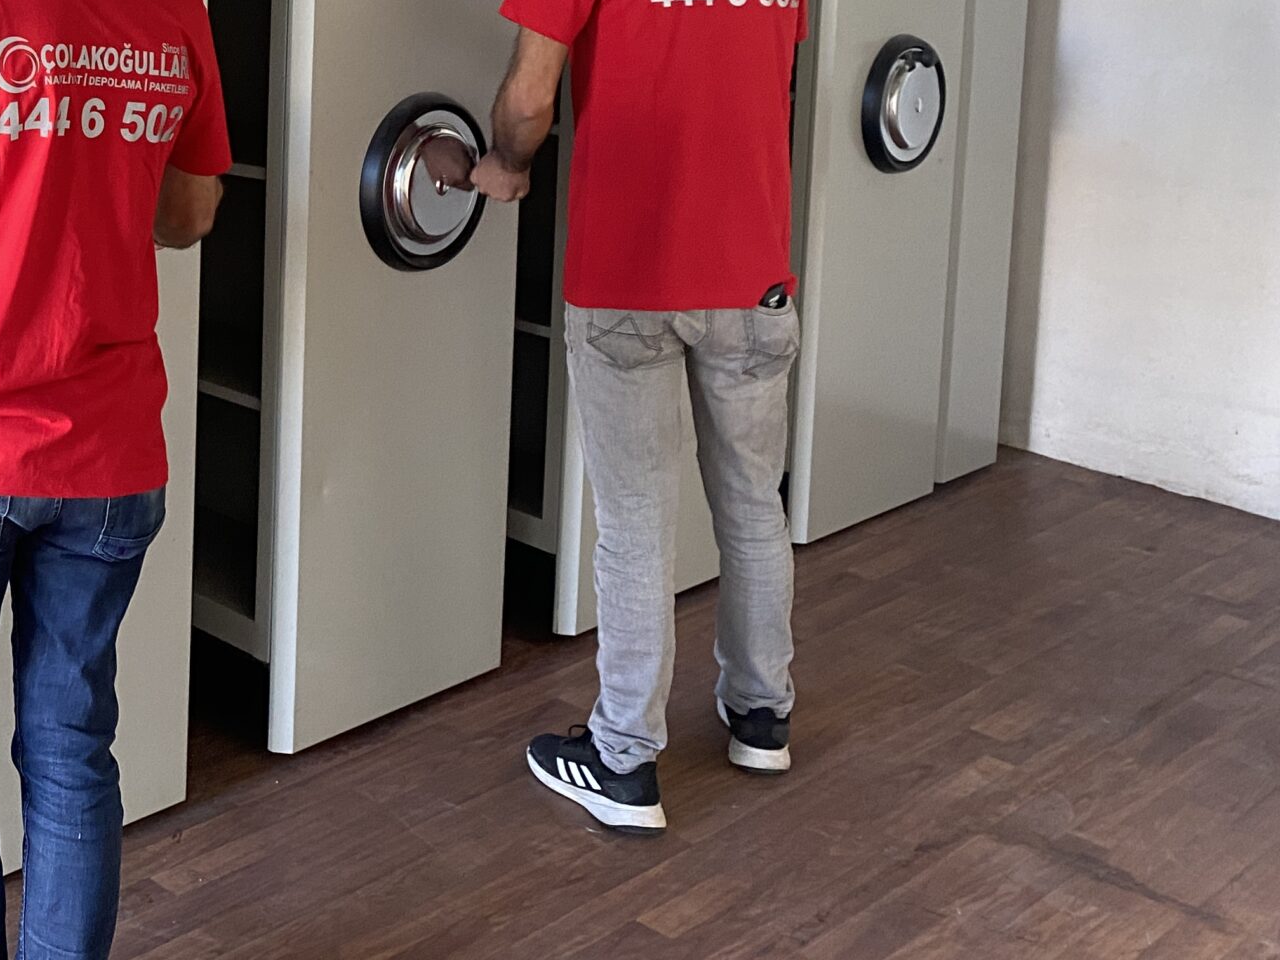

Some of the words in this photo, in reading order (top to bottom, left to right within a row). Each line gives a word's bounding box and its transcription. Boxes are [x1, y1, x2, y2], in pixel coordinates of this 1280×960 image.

[89, 76, 142, 91] DEPOLAMA
[81, 97, 106, 139] 6
[120, 101, 184, 144] 502
